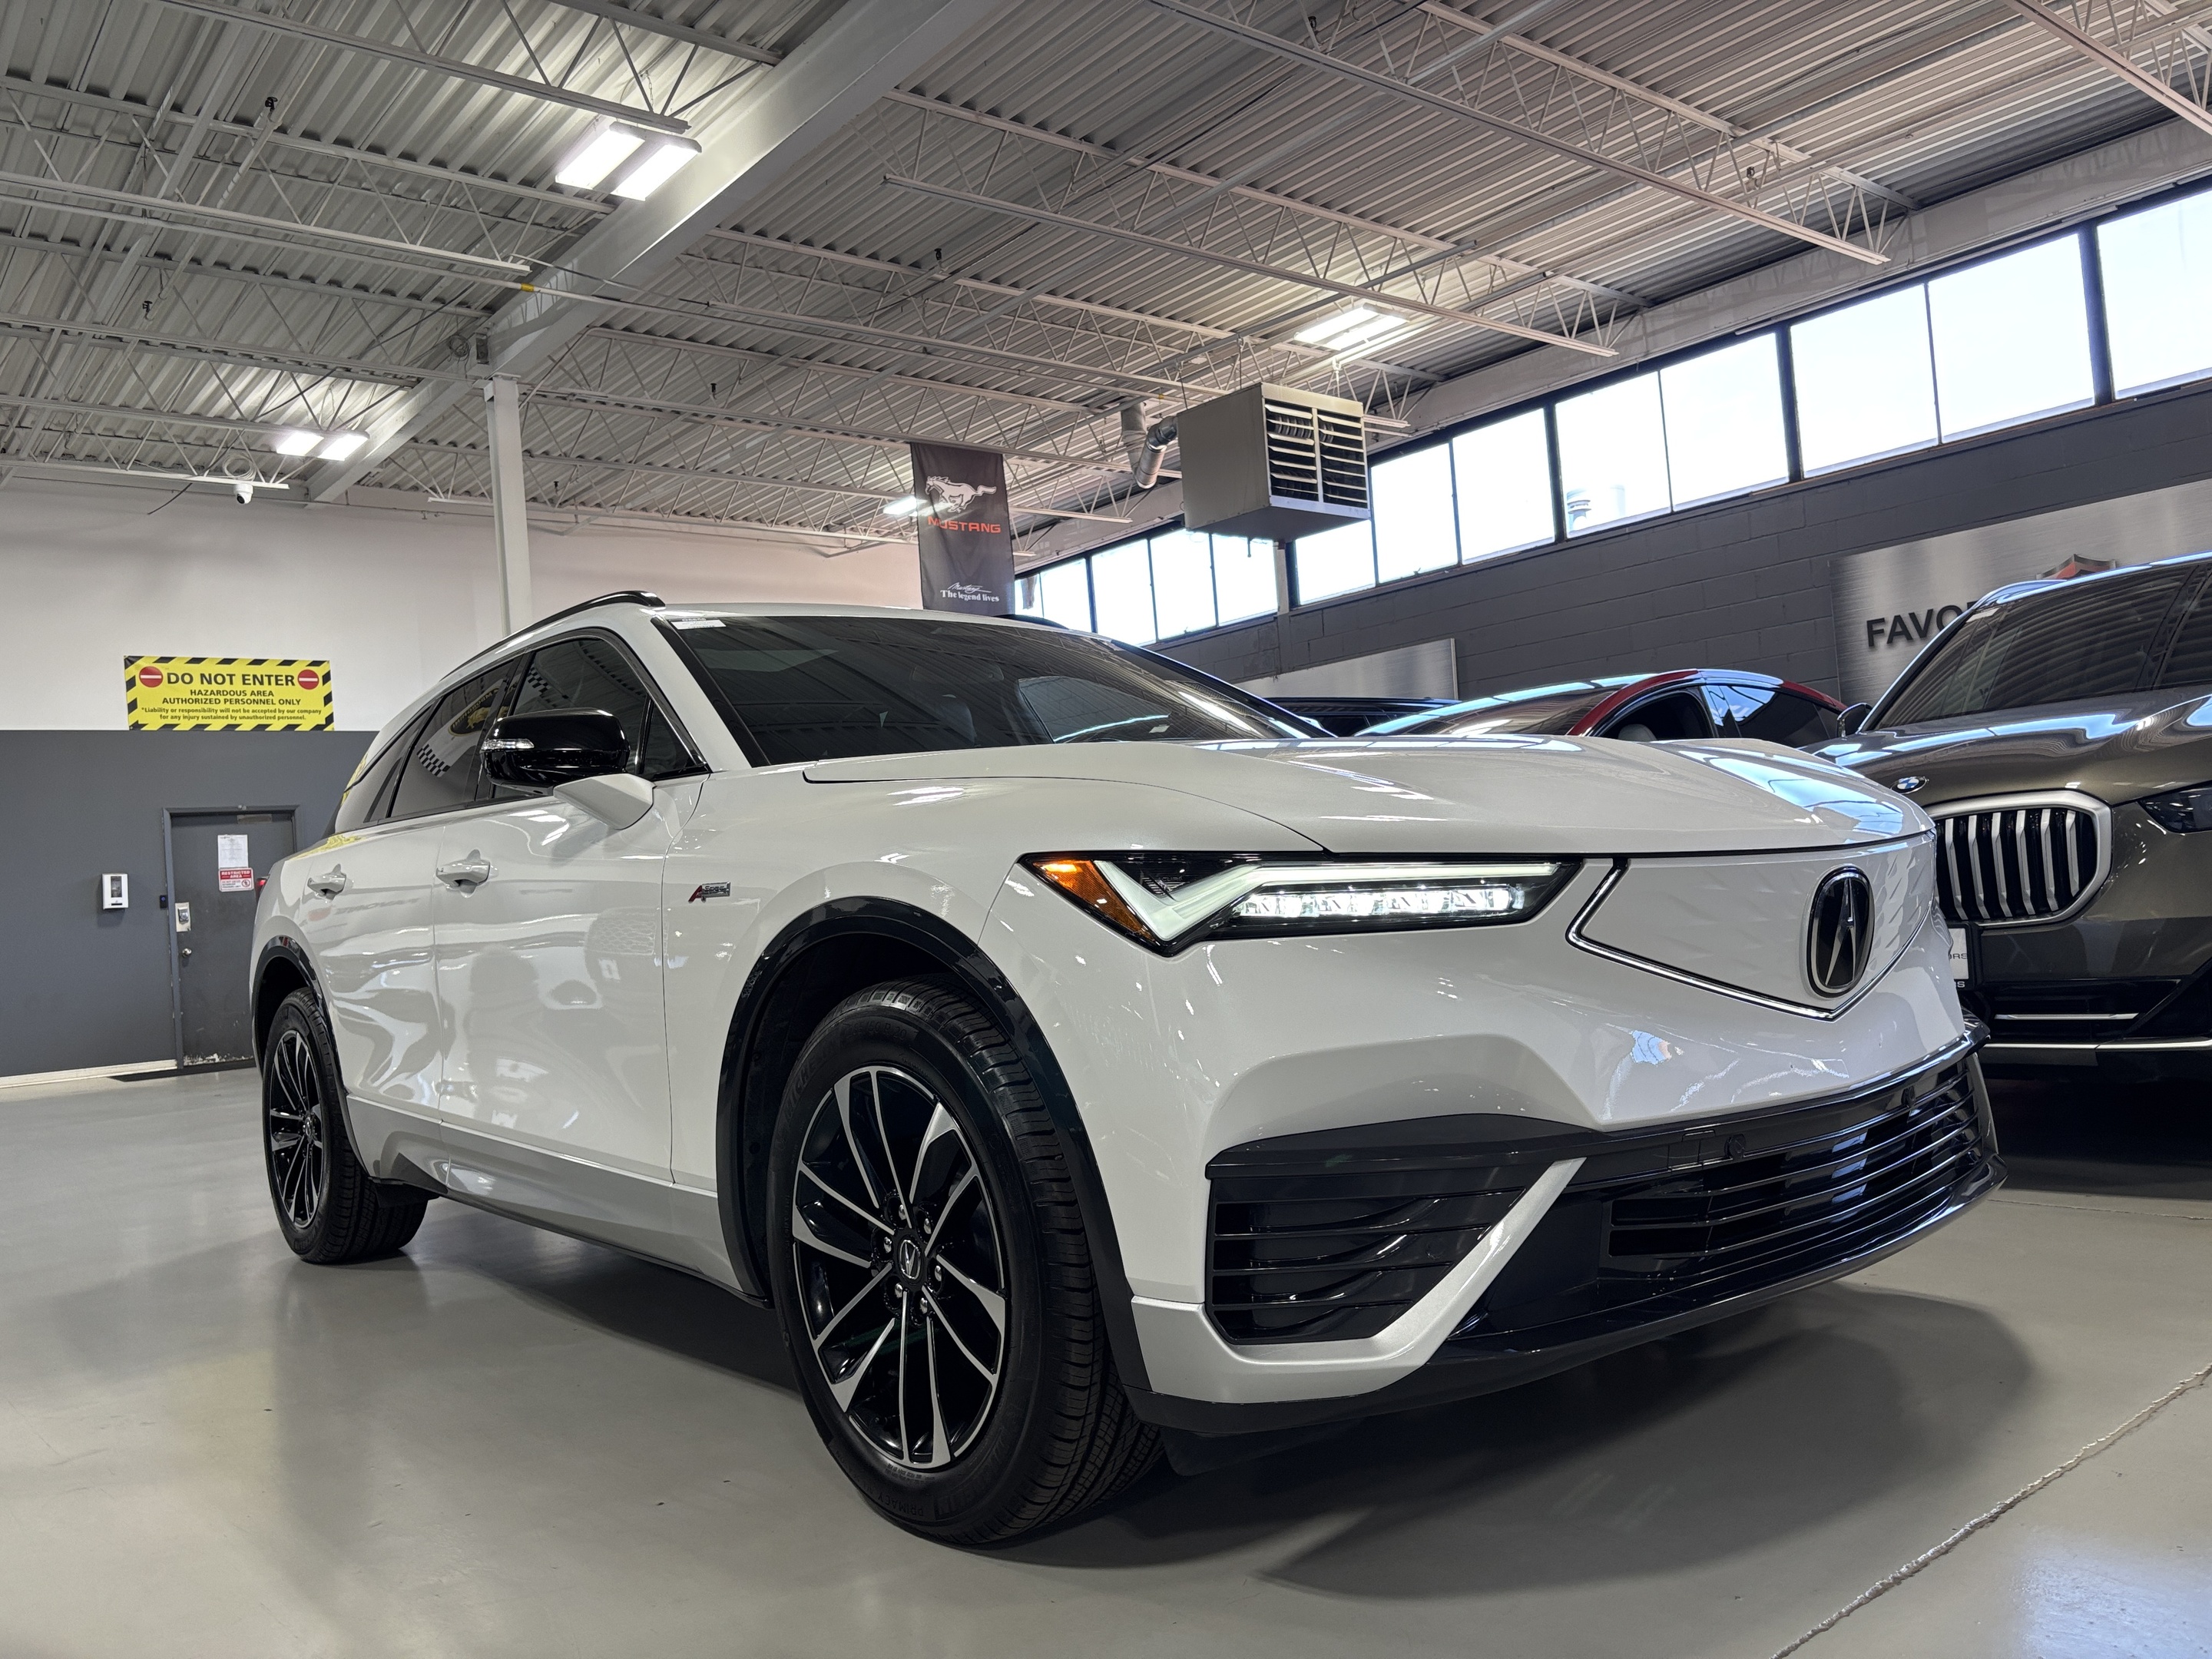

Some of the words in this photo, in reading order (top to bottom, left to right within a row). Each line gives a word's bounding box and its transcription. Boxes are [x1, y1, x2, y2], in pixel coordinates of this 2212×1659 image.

[928, 515, 1001, 533] MUSTANG
[939, 589, 957, 598] The
[958, 591, 982, 601] legend
[982, 594, 1000, 602] lives
[1866, 600, 1979, 647] FAVO
[167, 672, 194, 684] DO
[200, 673, 236, 686] NOT
[241, 674, 296, 687] ENTER
[178, 707, 217, 715] responsibility
[251, 707, 276, 716] accepted
